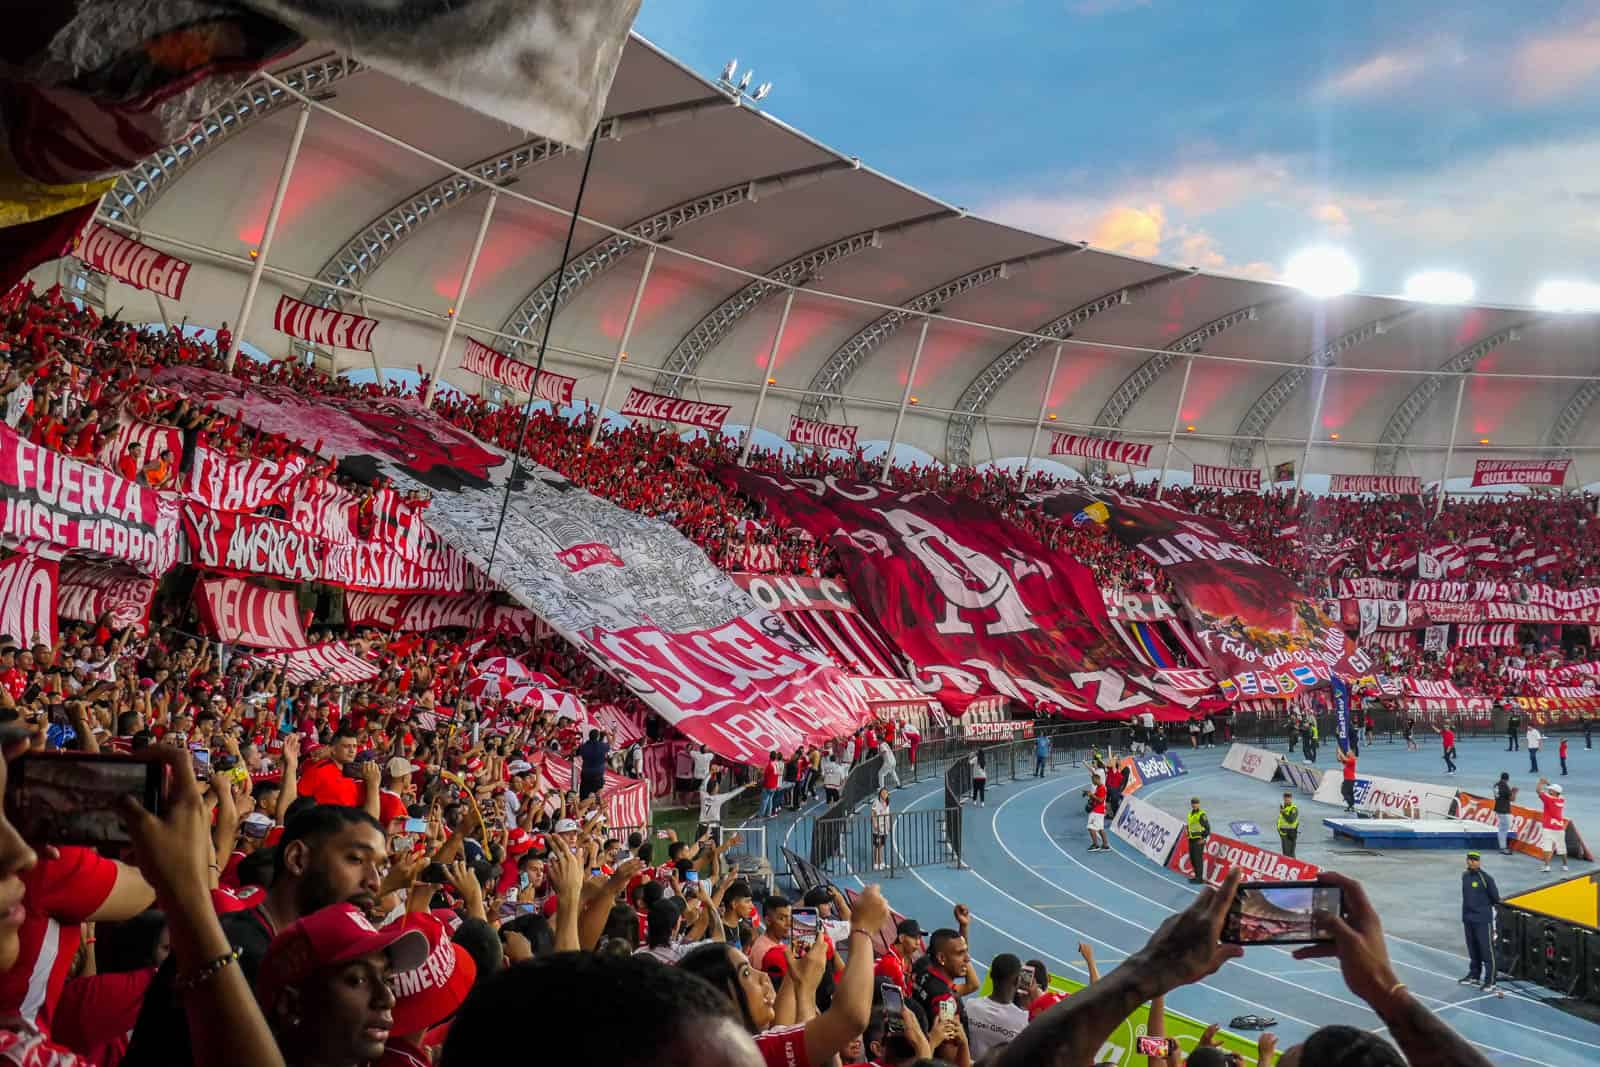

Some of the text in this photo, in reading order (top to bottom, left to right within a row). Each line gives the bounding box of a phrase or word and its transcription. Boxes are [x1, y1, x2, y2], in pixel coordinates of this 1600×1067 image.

[80, 224, 186, 298] mundi
[277, 298, 379, 349] YUMBO
[622, 391, 729, 428] BLOKE LOPEZ
[16, 436, 142, 524] FUERZA
[3, 498, 68, 546] JOSE
[1457, 624, 1517, 647] TULUA
[1203, 837, 1302, 880] osquillas
